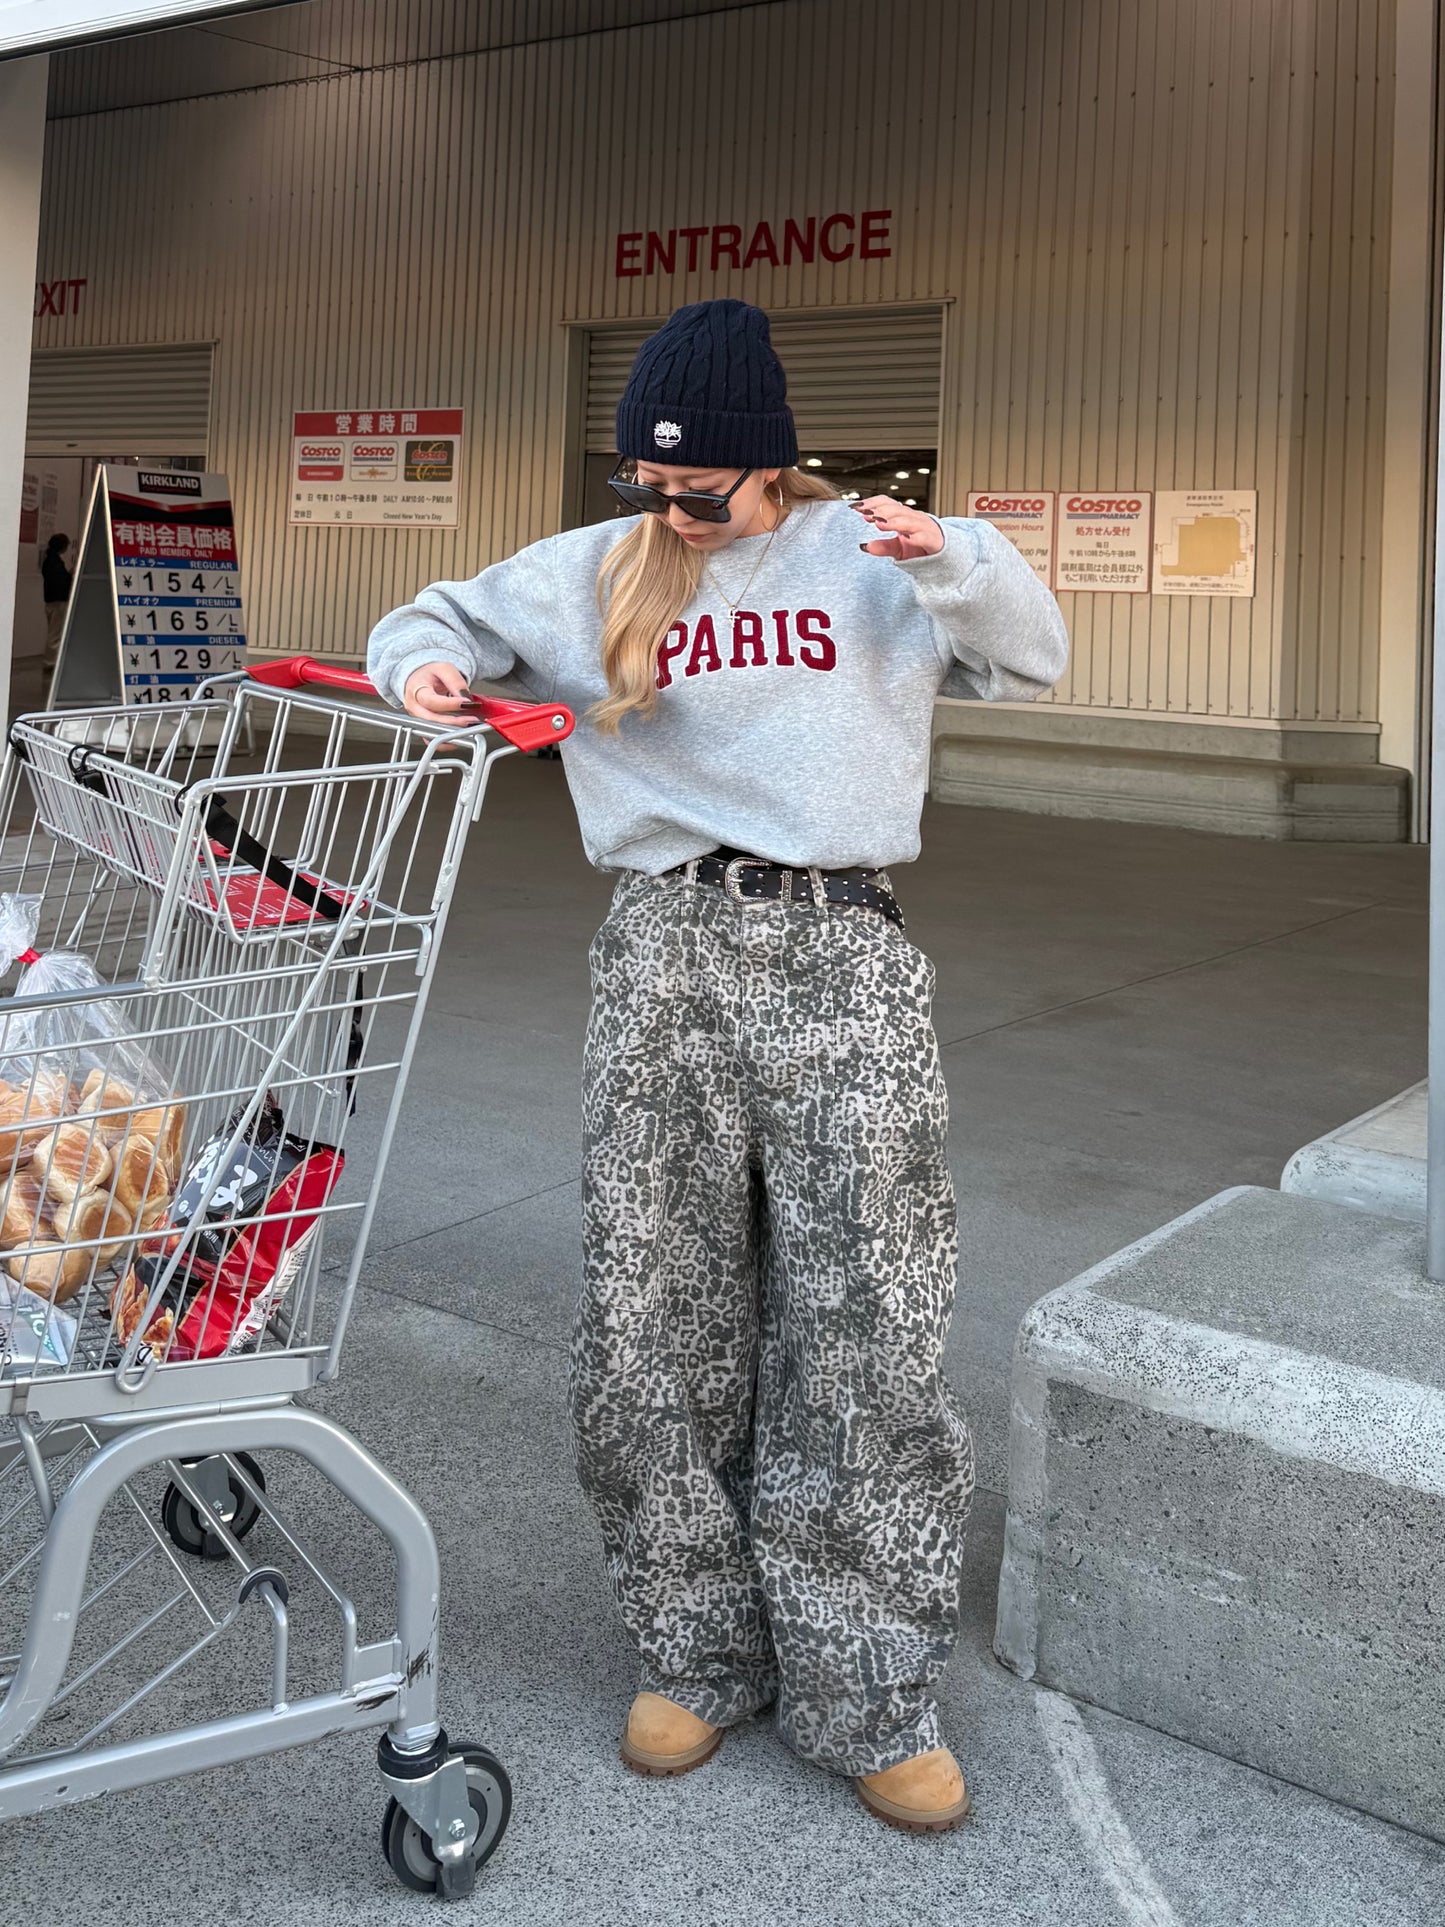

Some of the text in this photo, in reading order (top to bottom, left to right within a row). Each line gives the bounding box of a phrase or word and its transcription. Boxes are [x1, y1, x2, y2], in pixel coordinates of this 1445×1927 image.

[615, 209, 892, 279] ENTRANCE
[35, 278, 87, 318] XIT
[336, 413, 418, 434] 営業時間
[301, 445, 341, 457] COSTCO
[353, 445, 395, 457] COSTCO
[141, 474, 200, 489] KIRKLAND
[974, 496, 1046, 512] COSTCO
[1066, 497, 1142, 512] COSTCO
[1021, 523, 1044, 532] Hours
[1075, 526, 1131, 537] 処方せん受付
[114, 522, 232, 550] 有料会員価格
[139, 546, 213, 558] PAID MEMBER ONLY
[1035, 548, 1049, 556] PM
[120, 557, 165, 567] レギュラー
[189, 560, 233, 570] REGULAR
[123, 596, 160, 606] ハイオク
[195, 598, 237, 607] PREMIUM
[208, 636, 241, 645] DIESEL
[655, 608, 837, 690] PARIS
